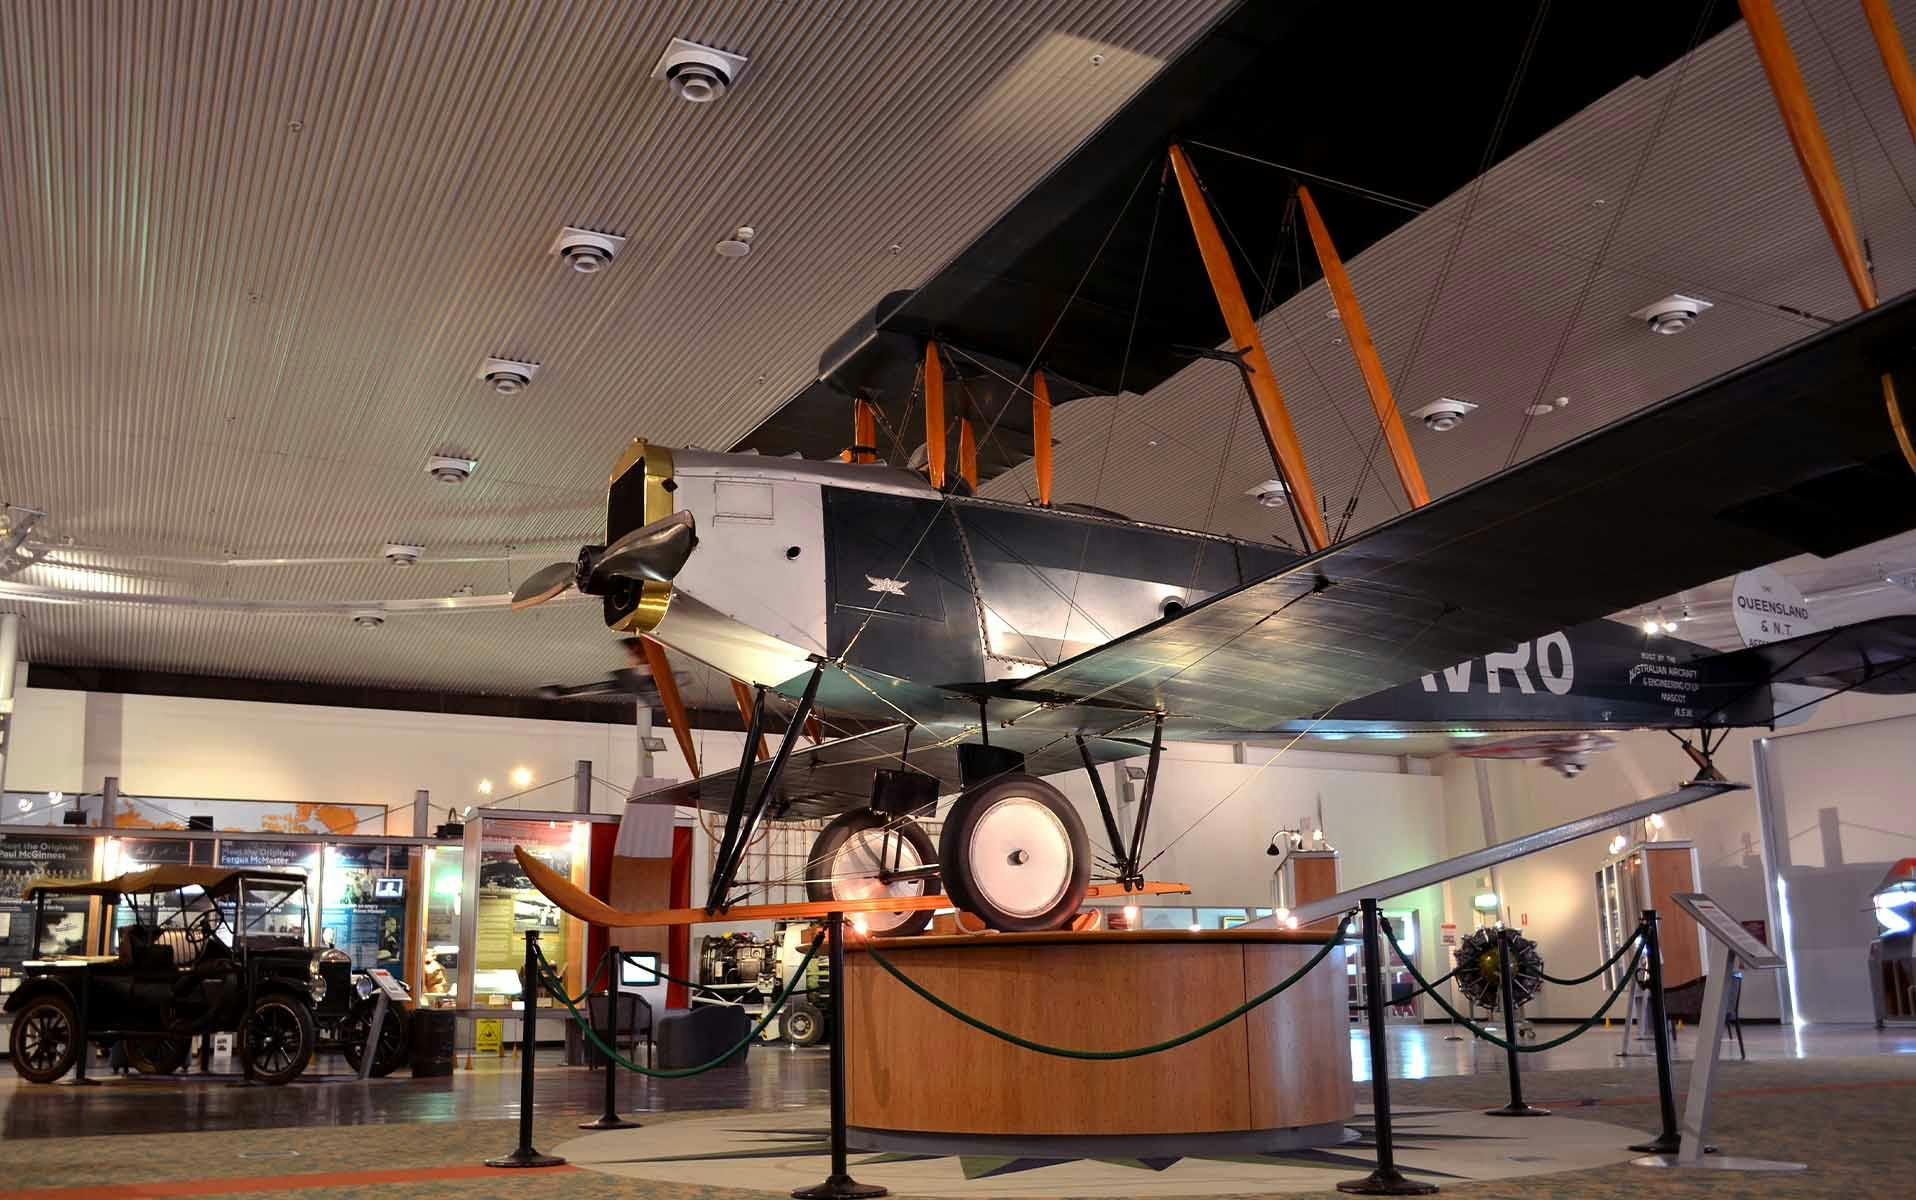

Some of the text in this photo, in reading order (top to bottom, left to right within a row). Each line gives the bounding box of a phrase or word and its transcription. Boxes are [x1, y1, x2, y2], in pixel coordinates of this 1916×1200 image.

[1737, 595, 1809, 620] QUEENSLAND
[1761, 619, 1769, 633] &
[1421, 631, 1574, 695] VRO
[1629, 663, 1697, 684] AUSTRALIAN AIRCRAFT
[1661, 692, 1686, 703] MASCOT
[0, 849, 66, 860] Paul McGinness
[221, 855, 289, 866] Fergus McMaster
